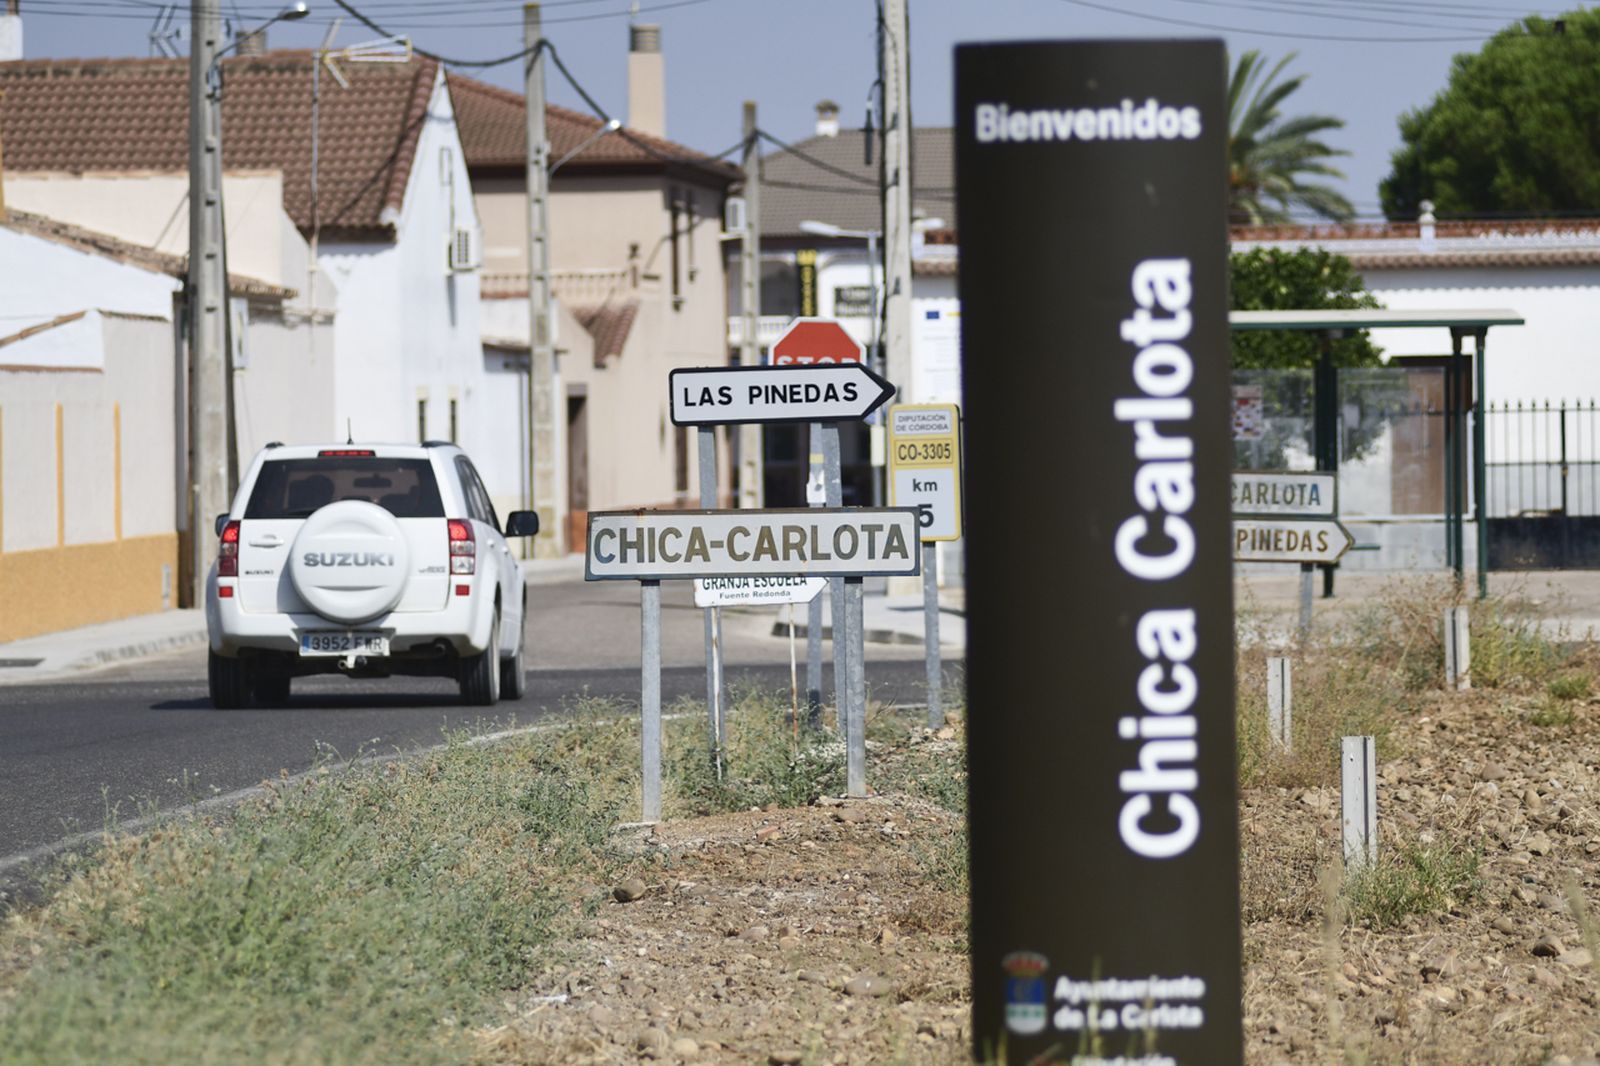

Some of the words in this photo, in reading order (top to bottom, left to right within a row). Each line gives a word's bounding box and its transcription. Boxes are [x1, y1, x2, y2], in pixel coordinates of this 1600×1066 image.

[975, 98, 1201, 142] Bienvenidos
[684, 386, 733, 406] LAS
[749, 382, 858, 404] PINEDAS
[1113, 257, 1196, 580] Carlota
[898, 443, 951, 461] CO-3305
[912, 479, 938, 492] km
[918, 504, 934, 528] 5
[593, 524, 909, 564] CHICA-CARLOTA
[1236, 528, 1329, 552] PINEDAS
[304, 553, 395, 567] SUZUKI
[753, 590, 791, 598] Redonda
[312, 637, 350, 650] 3952
[1118, 608, 1200, 858] Chica
